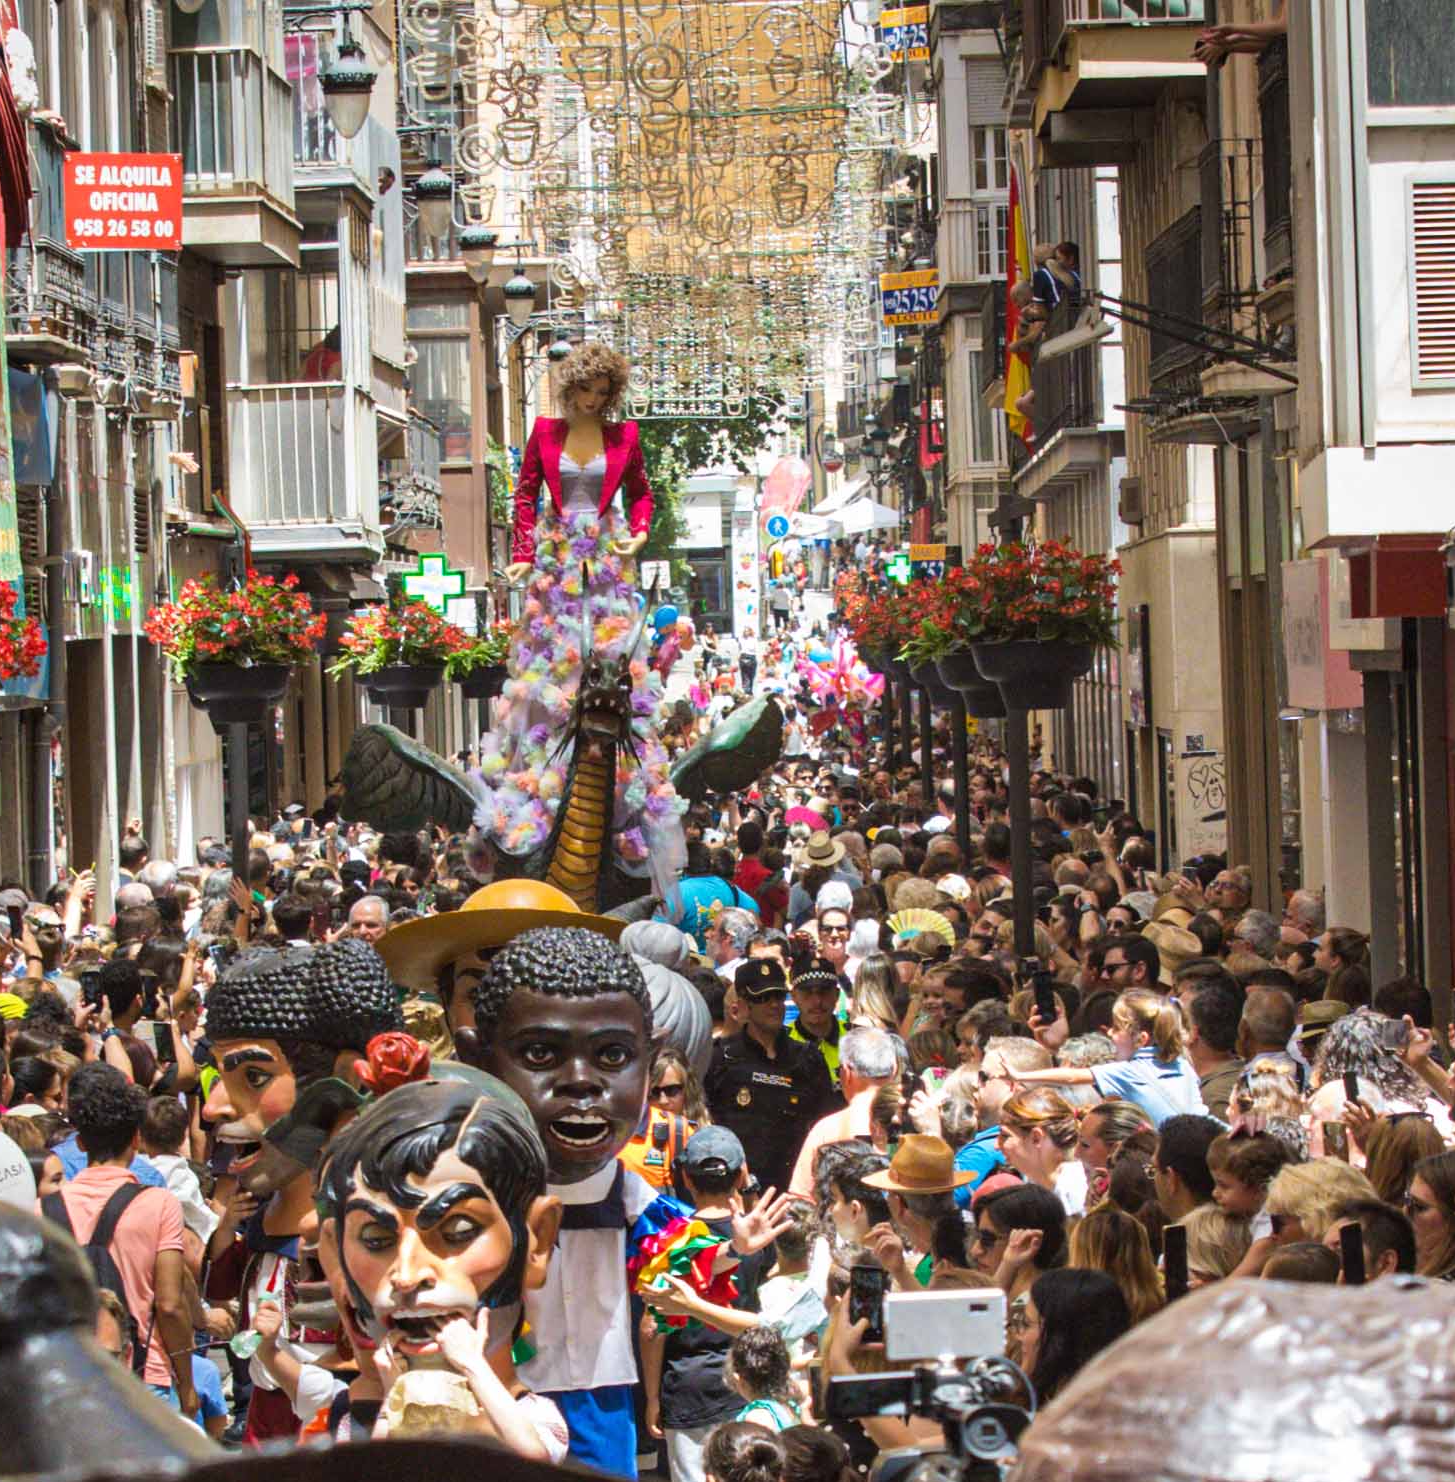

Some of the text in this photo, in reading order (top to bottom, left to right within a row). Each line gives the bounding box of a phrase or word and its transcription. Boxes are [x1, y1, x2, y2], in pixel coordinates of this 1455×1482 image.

[74, 165, 173, 187] SE ALQUILA
[89, 191, 159, 212] OFICINA
[73, 218, 174, 238] 958 26 58 00
